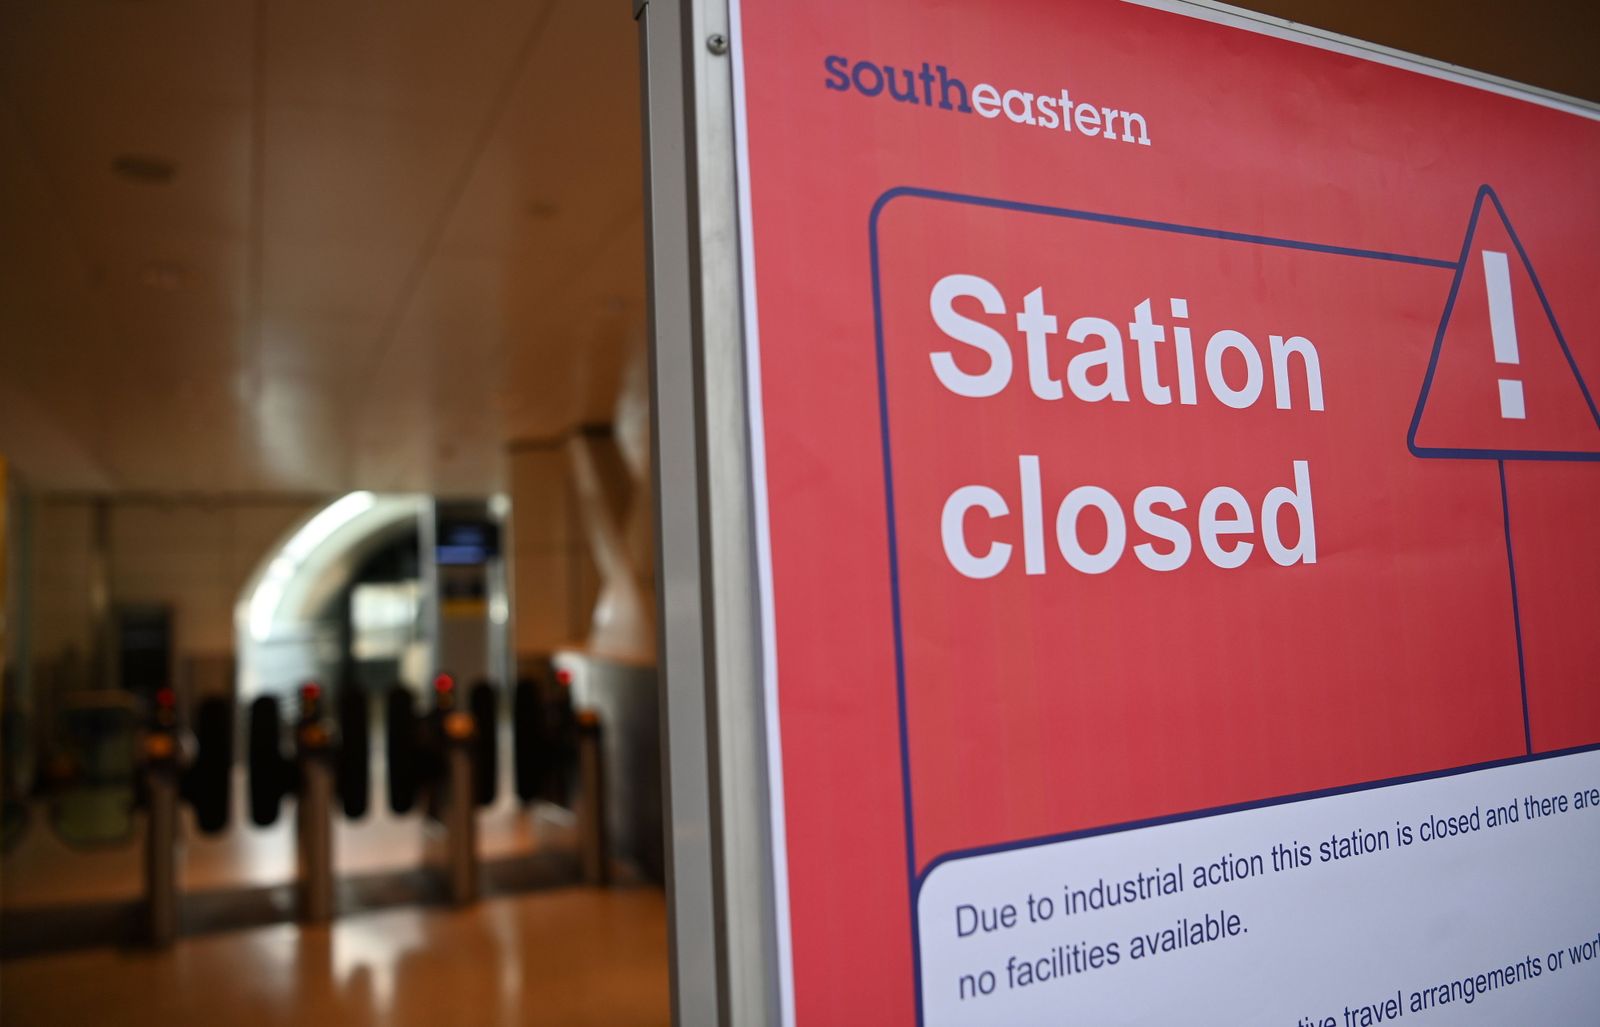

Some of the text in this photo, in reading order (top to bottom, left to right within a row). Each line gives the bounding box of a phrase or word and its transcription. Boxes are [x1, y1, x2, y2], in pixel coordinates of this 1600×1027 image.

[824, 54, 1152, 146] southeastern
[929, 273, 1325, 412] Station
[940, 454, 1317, 579] closed
[955, 788, 1600, 938] Due to industrial action this station is closed and there are
[958, 909, 1249, 999] no facilities available.
[1343, 989, 1404, 1027] travel
[1409, 954, 1544, 1014] arrangements
[1545, 950, 1565, 973] or
